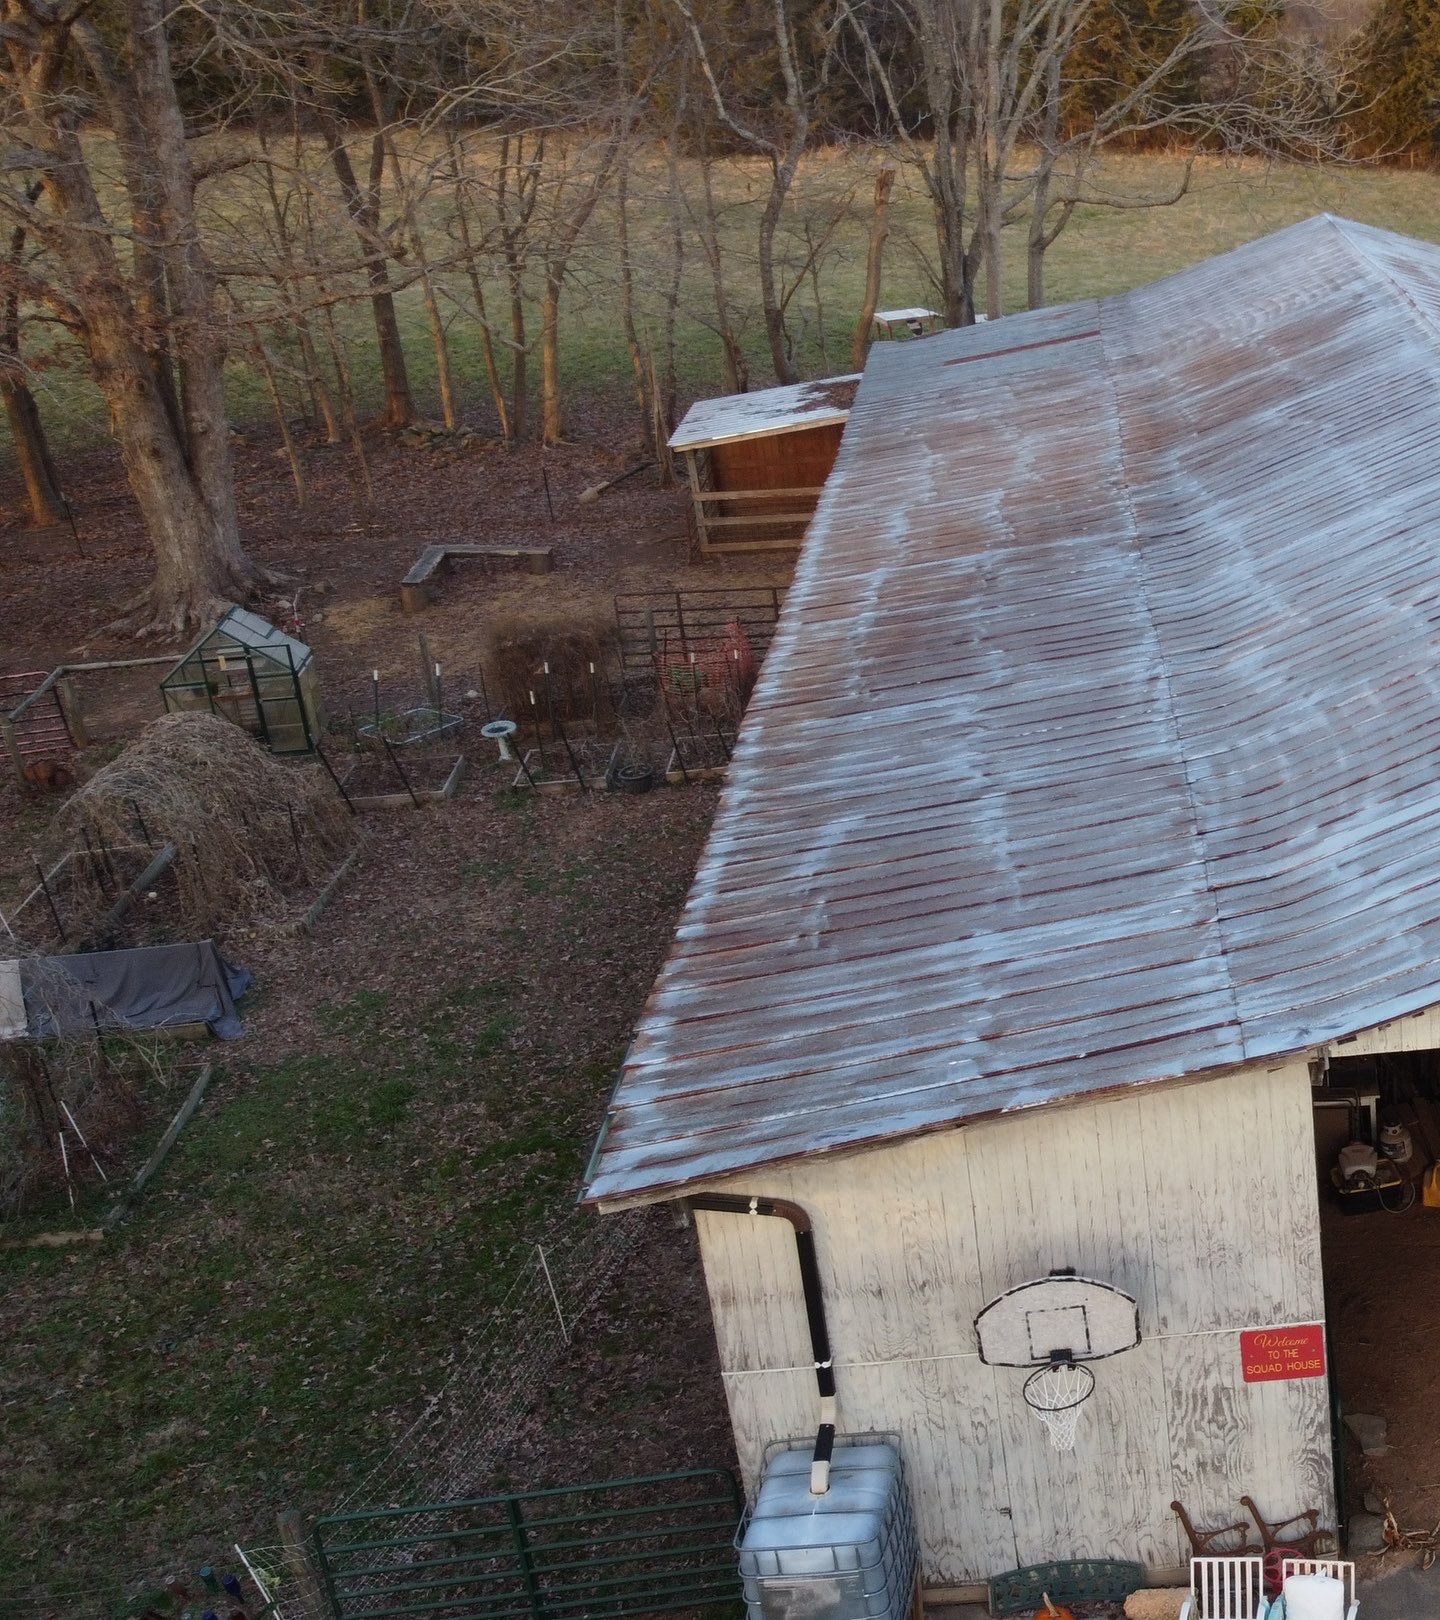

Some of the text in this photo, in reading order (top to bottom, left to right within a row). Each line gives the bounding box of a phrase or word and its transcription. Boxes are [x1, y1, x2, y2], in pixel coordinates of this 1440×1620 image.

[1254, 1334, 1308, 1347] Welcome
[1268, 1349, 1299, 1360] TO THE
[1246, 1359, 1322, 1374] SQUAD HOUSE
